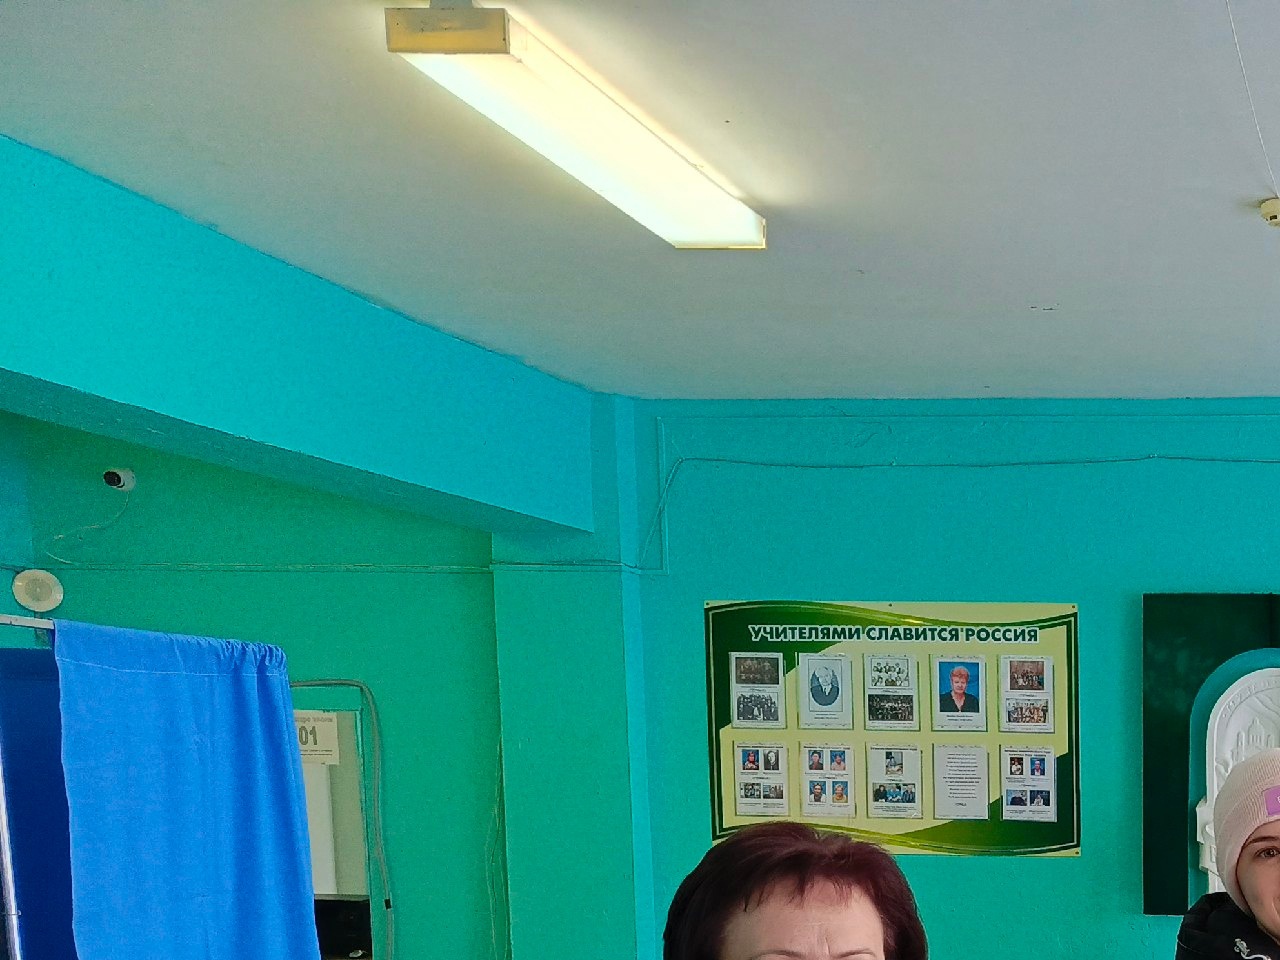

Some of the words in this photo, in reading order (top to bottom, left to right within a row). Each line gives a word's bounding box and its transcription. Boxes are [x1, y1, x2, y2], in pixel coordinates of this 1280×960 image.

[749, 625, 861, 640] УЧИТЕЛЯМИ
[865, 626, 960, 641] СЛАВИТСЯ
[965, 627, 1038, 642] РОССИЯ
